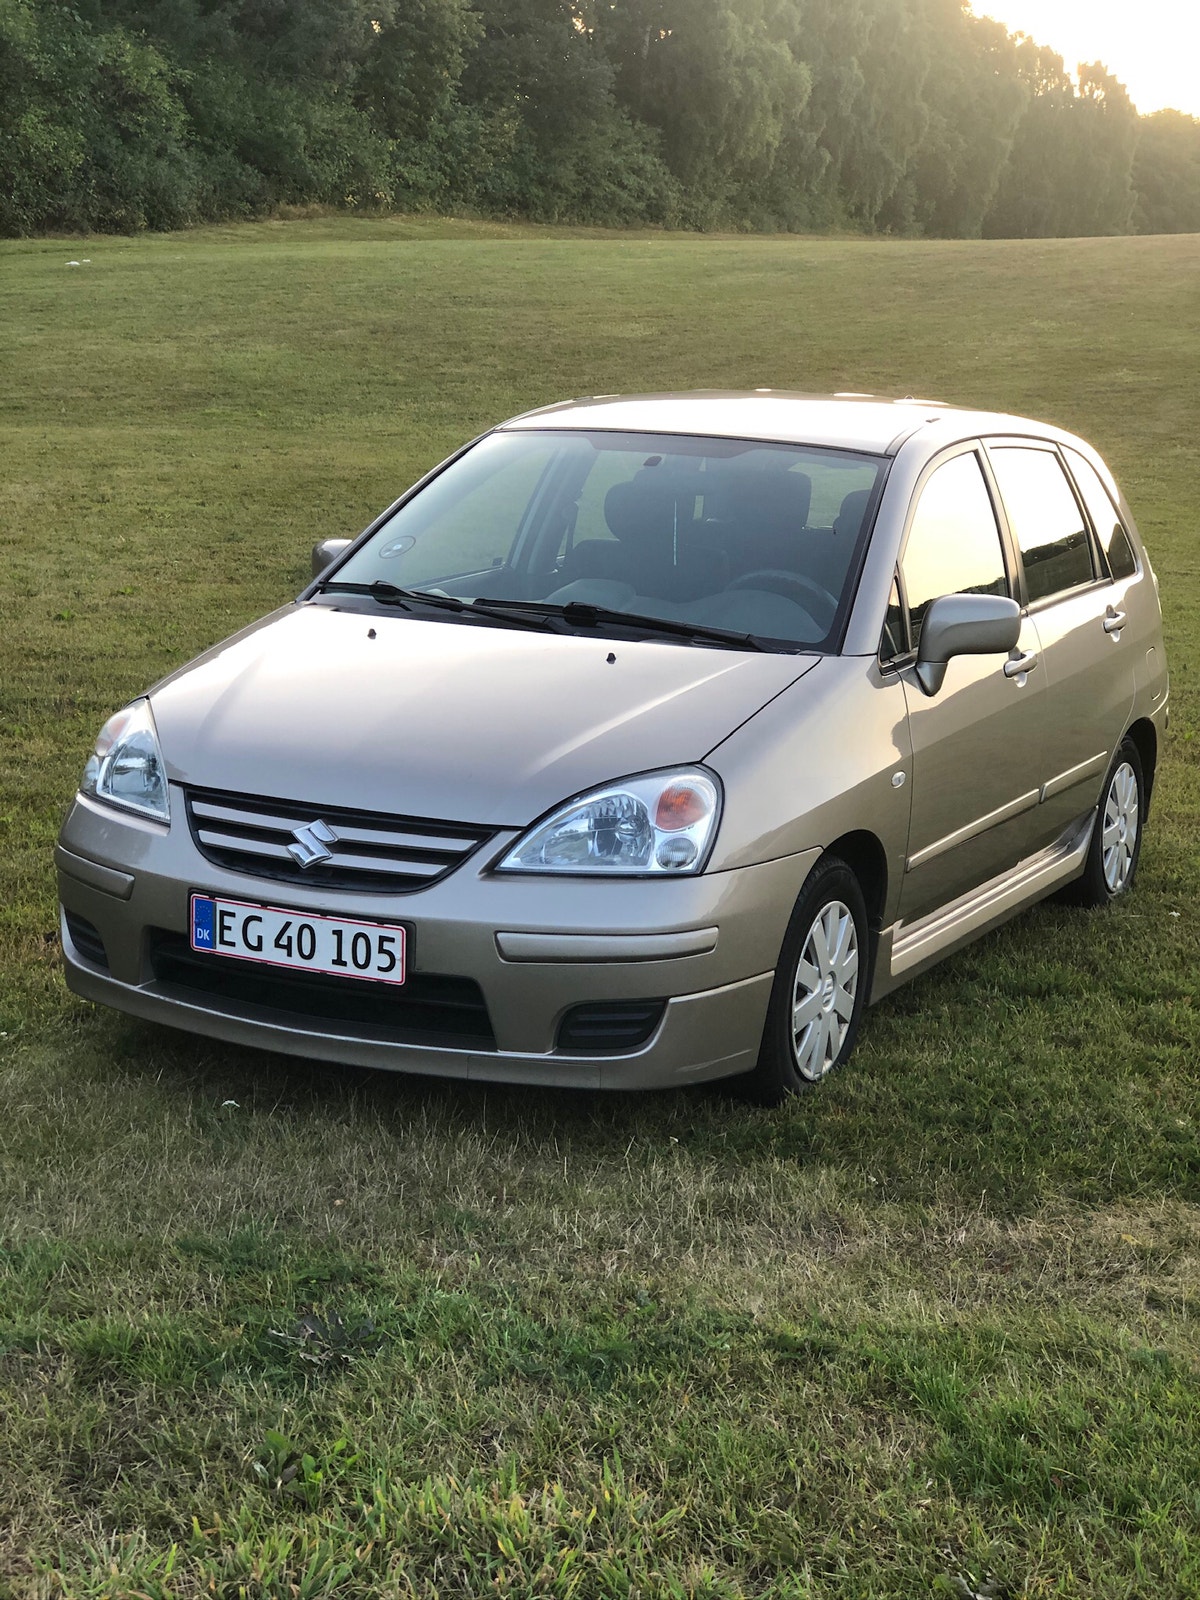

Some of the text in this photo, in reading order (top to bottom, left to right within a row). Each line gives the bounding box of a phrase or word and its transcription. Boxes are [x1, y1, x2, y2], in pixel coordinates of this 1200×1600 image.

[196, 928, 210, 941] DK
[219, 909, 396, 973] EG 40 105
